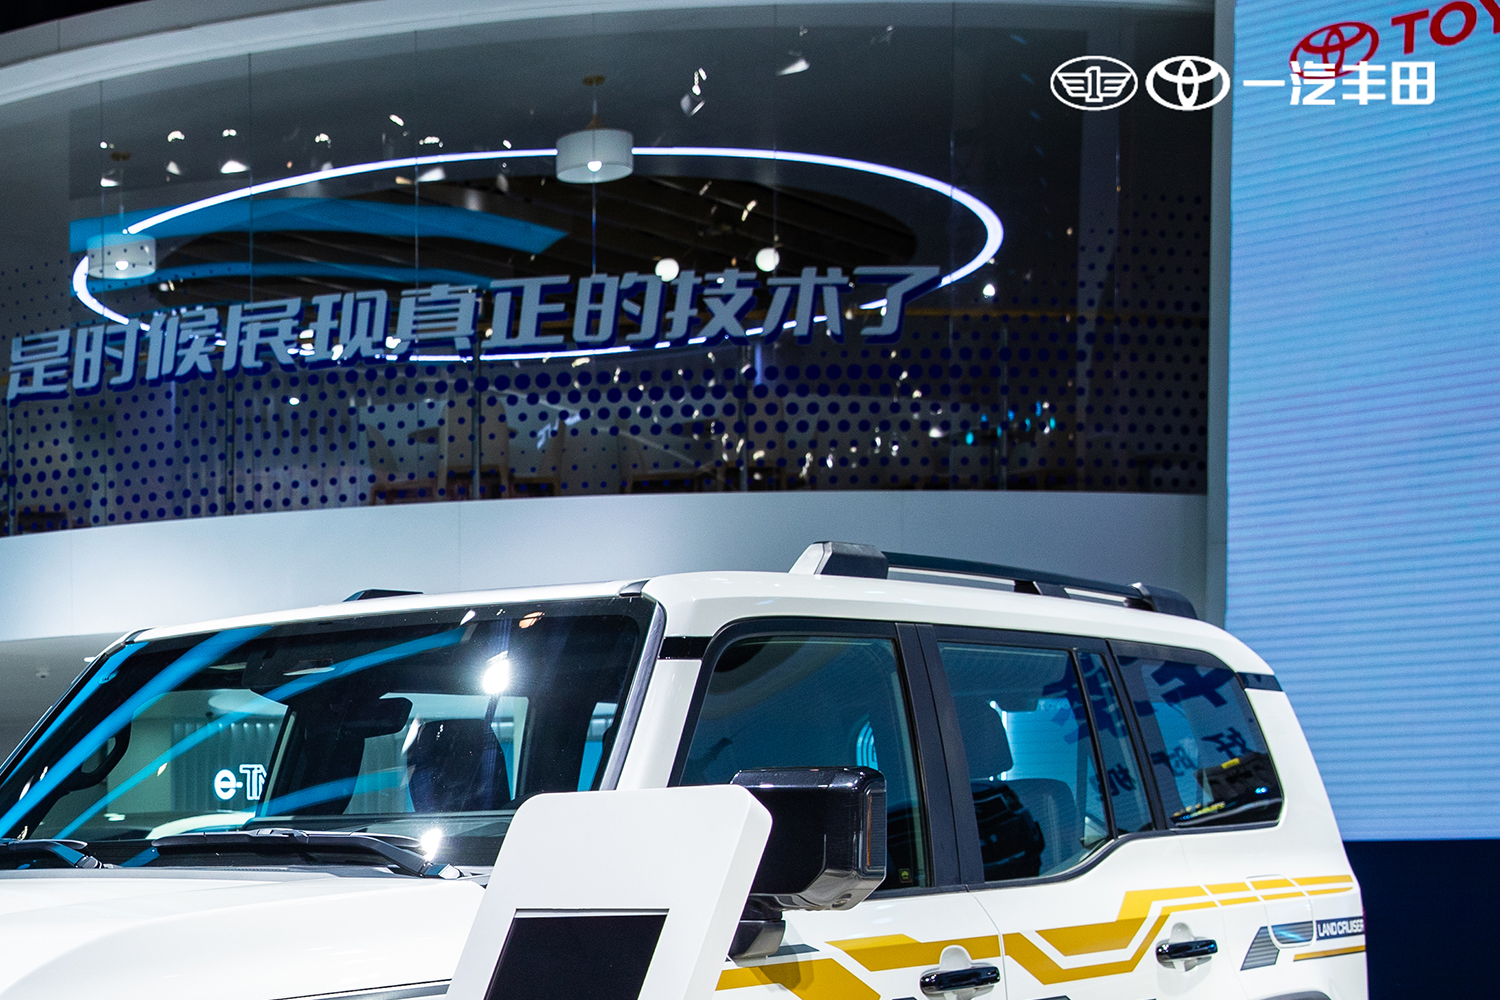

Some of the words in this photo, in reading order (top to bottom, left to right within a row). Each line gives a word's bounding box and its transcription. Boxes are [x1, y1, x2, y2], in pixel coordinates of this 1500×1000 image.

[7, 265, 942, 401] 是时候展现真正的技术了
[1317, 921, 1337, 937] LAND
